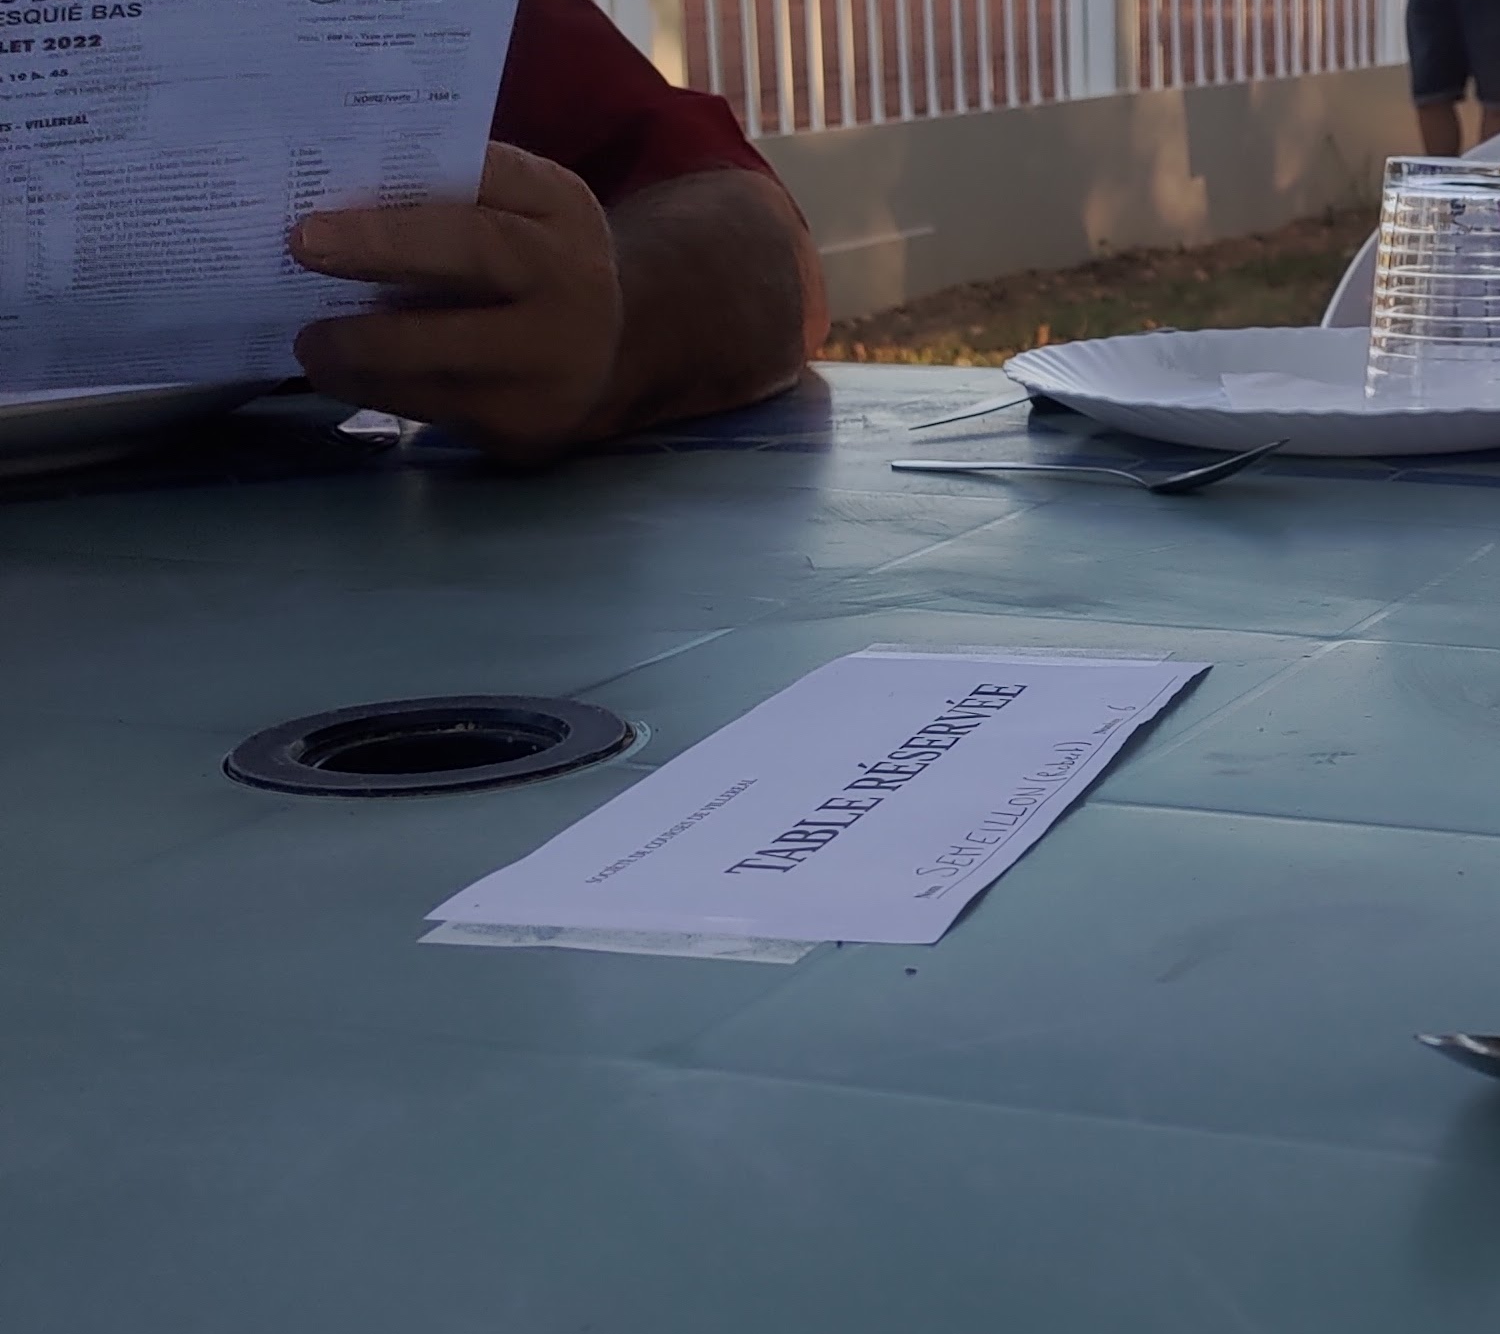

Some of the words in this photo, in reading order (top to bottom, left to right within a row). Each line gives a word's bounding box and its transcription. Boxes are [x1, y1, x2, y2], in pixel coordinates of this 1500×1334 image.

[92, 2, 143, 20] BAS
[42, 34, 103, 51] 2022
[724, 797, 885, 875] TABLE
[842, 683, 1029, 792] RÉSERVÉE
